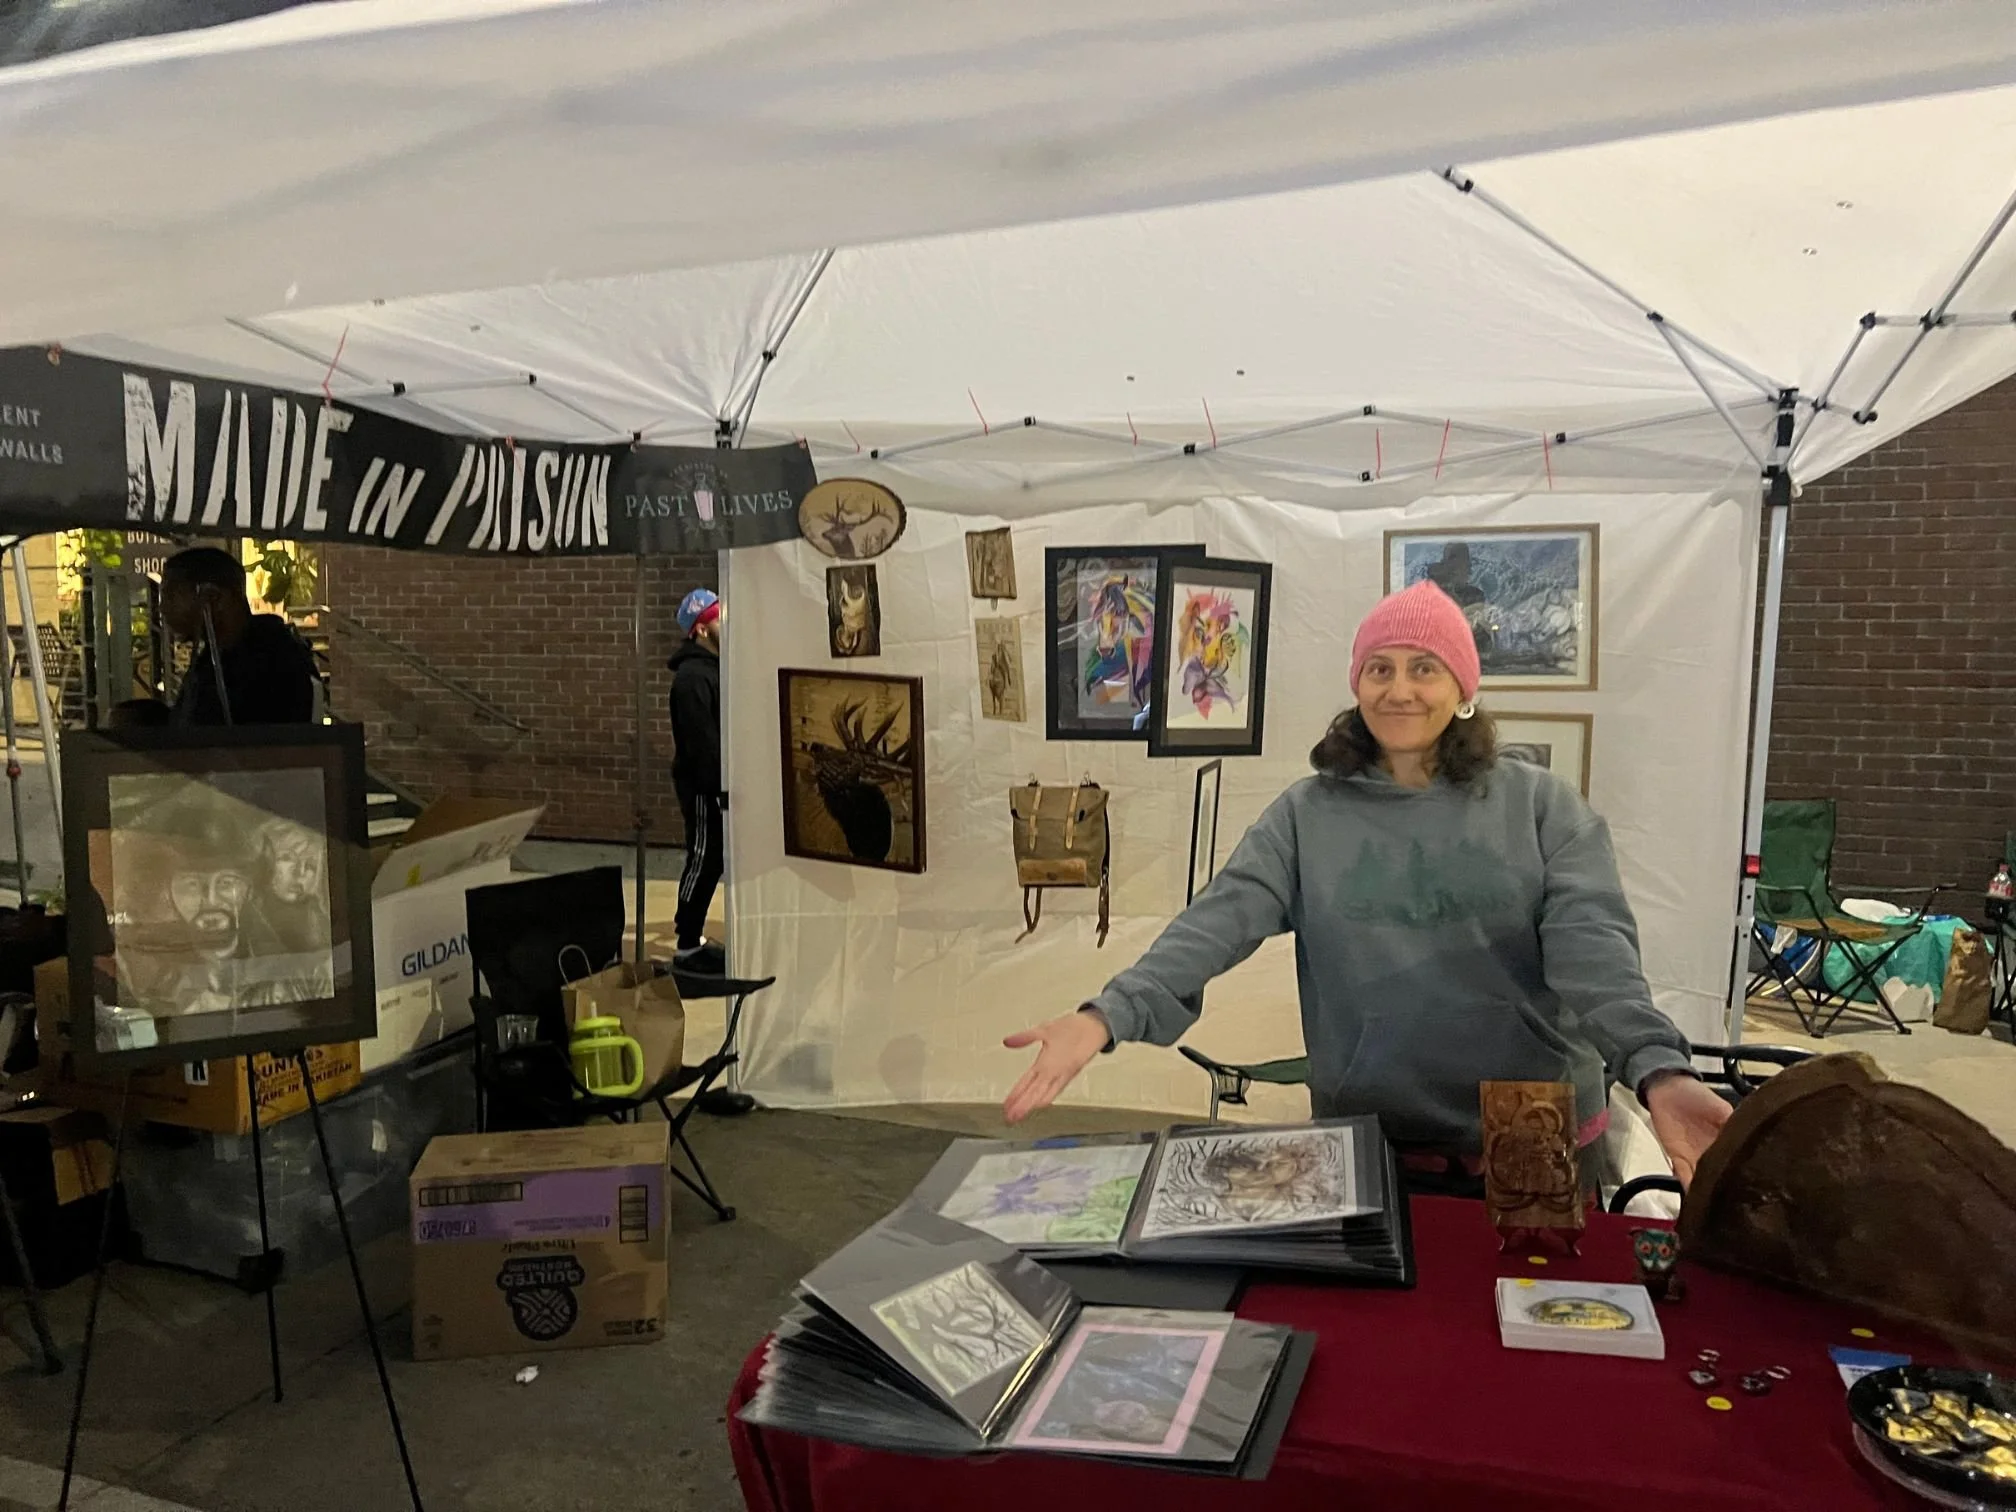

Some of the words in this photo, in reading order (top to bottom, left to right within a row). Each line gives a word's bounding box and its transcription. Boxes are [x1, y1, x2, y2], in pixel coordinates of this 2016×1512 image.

[0, 404, 41, 428] ENT
[122, 371, 354, 531] MADE
[348, 456, 425, 539] IN
[423, 444, 612, 552] PRISON
[624, 494, 689, 520] PAST
[720, 488, 794, 517] LIVES
[310, 1062, 352, 1085] AKISTAN
[500, 1269, 582, 1287] QUILTED
